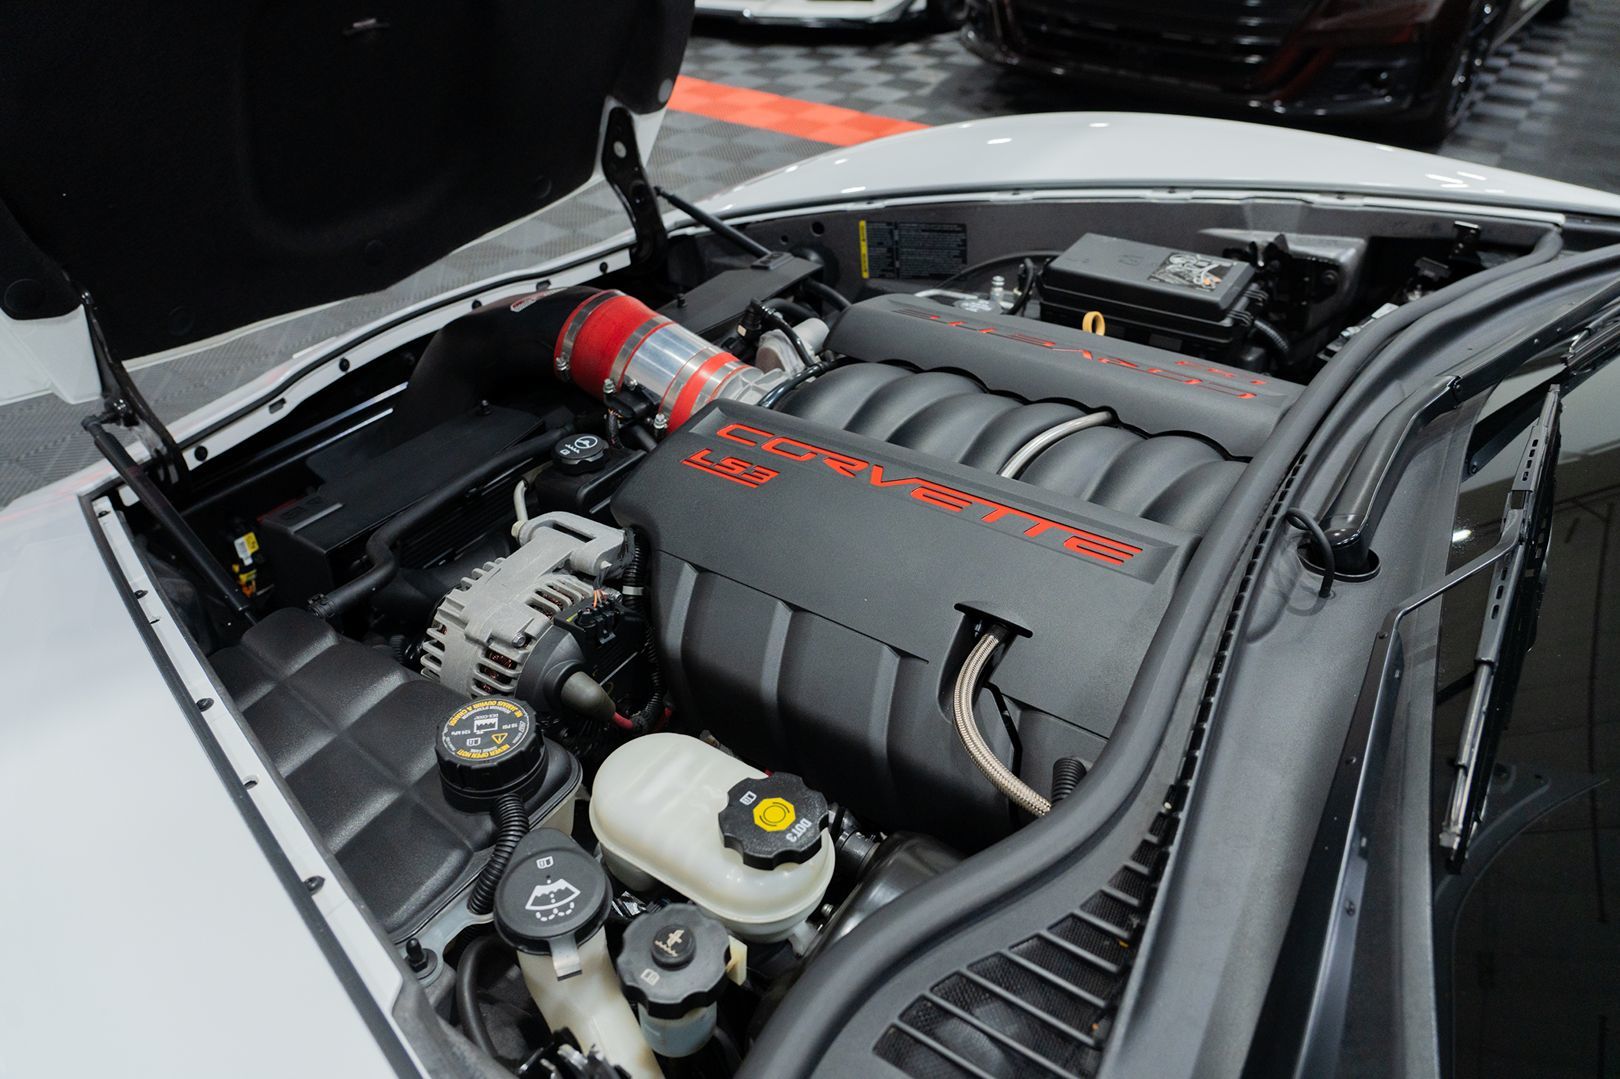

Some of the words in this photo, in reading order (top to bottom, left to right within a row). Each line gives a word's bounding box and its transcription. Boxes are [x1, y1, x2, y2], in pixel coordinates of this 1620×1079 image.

[682, 448, 779, 487] LS3
[716, 423, 1143, 566] CORVETTE
[470, 751, 489, 759] OPEN
[489, 744, 511, 757] NEVER
[786, 818, 812, 842] DOT3
